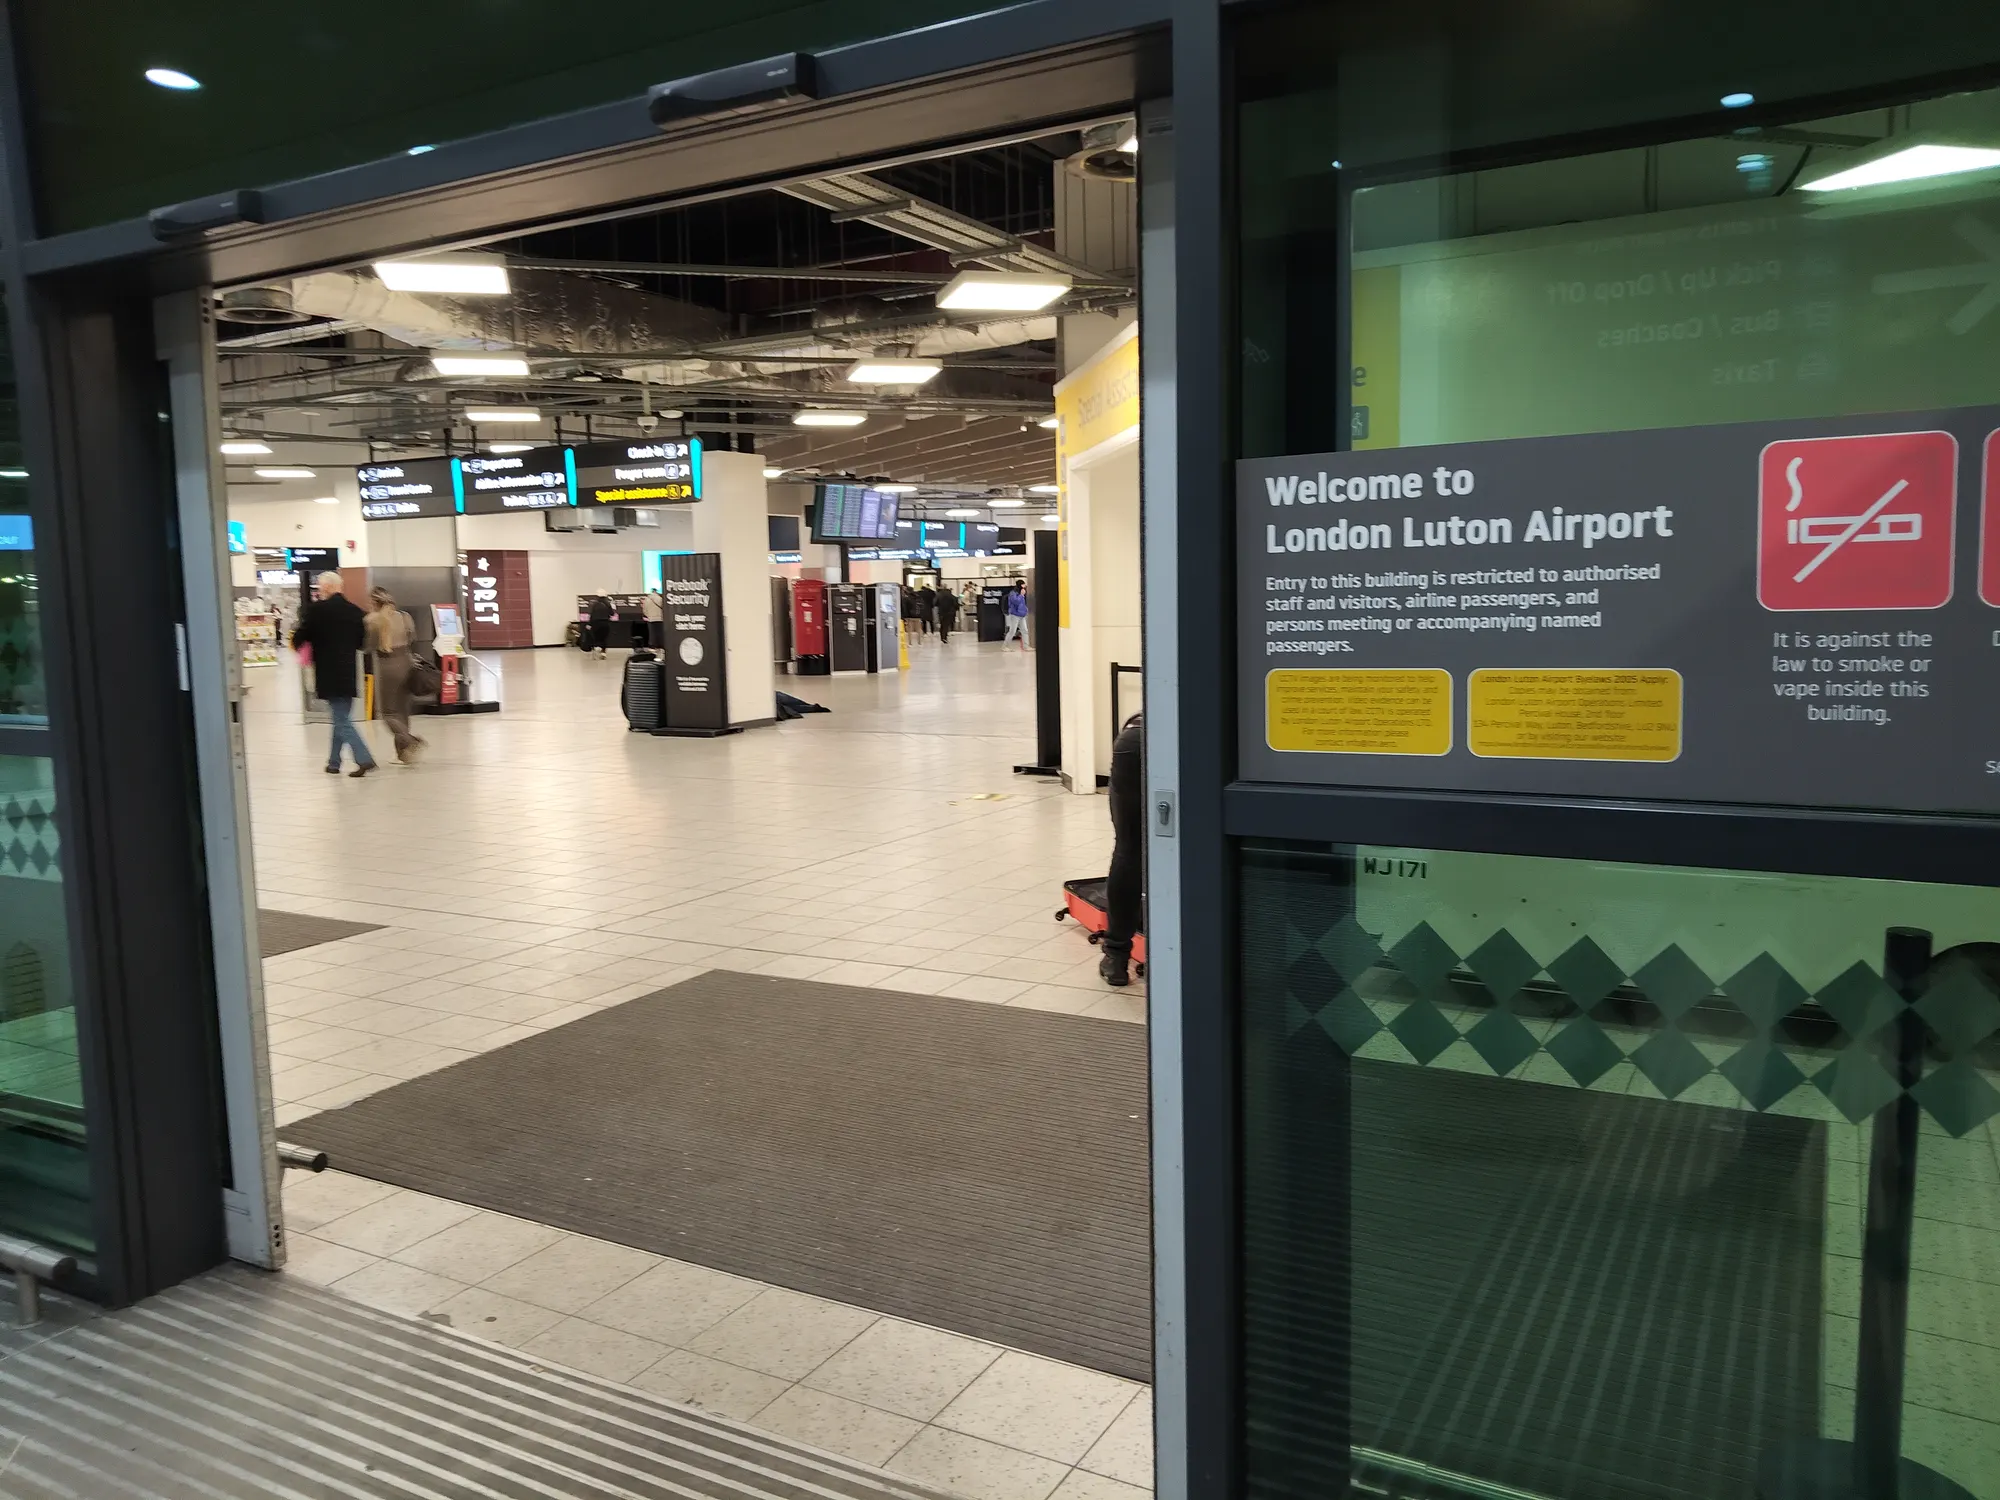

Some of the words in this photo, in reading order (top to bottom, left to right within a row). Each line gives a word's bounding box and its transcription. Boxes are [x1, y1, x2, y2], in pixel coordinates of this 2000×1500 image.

[1265, 472, 1423, 506] Welcome
[1433, 467, 1475, 496] to
[1266, 519, 1392, 553] London
[1403, 516, 1512, 547] Luton
[1523, 506, 1674, 548] Airport
[1266, 576, 1307, 593] Entry
[1310, 576, 1327, 589] to
[1331, 574, 1361, 588] this
[1365, 572, 1428, 589] building
[1432, 571, 1447, 586] is
[1450, 568, 1534, 585] restricted
[1539, 568, 1558, 582] to
[1563, 563, 1660, 582] authorised
[472, 577, 499, 625] PRET
[1266, 596, 1304, 611] staff
[1307, 595, 1335, 611] and
[1339, 595, 1402, 610] visitors,
[1405, 593, 1456, 608] airline
[1461, 593, 1562, 610] passengers,
[1565, 589, 1598, 604] and
[1266, 619, 1324, 635] persons
[1327, 616, 1392, 633] meeting
[1396, 618, 1413, 630] or
[1417, 613, 1536, 632] accompanying
[1541, 612, 1601, 627] named
[1266, 640, 1354, 655] passengers.
[1773, 632, 1789, 648] It
[1795, 631, 1811, 648] is
[1815, 631, 1891, 651] against
[1897, 630, 1932, 647] the
[1772, 656, 1806, 672] law
[1811, 658, 1833, 672] to
[1838, 656, 1904, 672] smoke
[1909, 659, 1932, 672] or
[1773, 683, 1820, 700] vape
[1825, 680, 1884, 697] inside
[1889, 680, 1929, 697] this
[1807, 704, 1891, 726] building.
